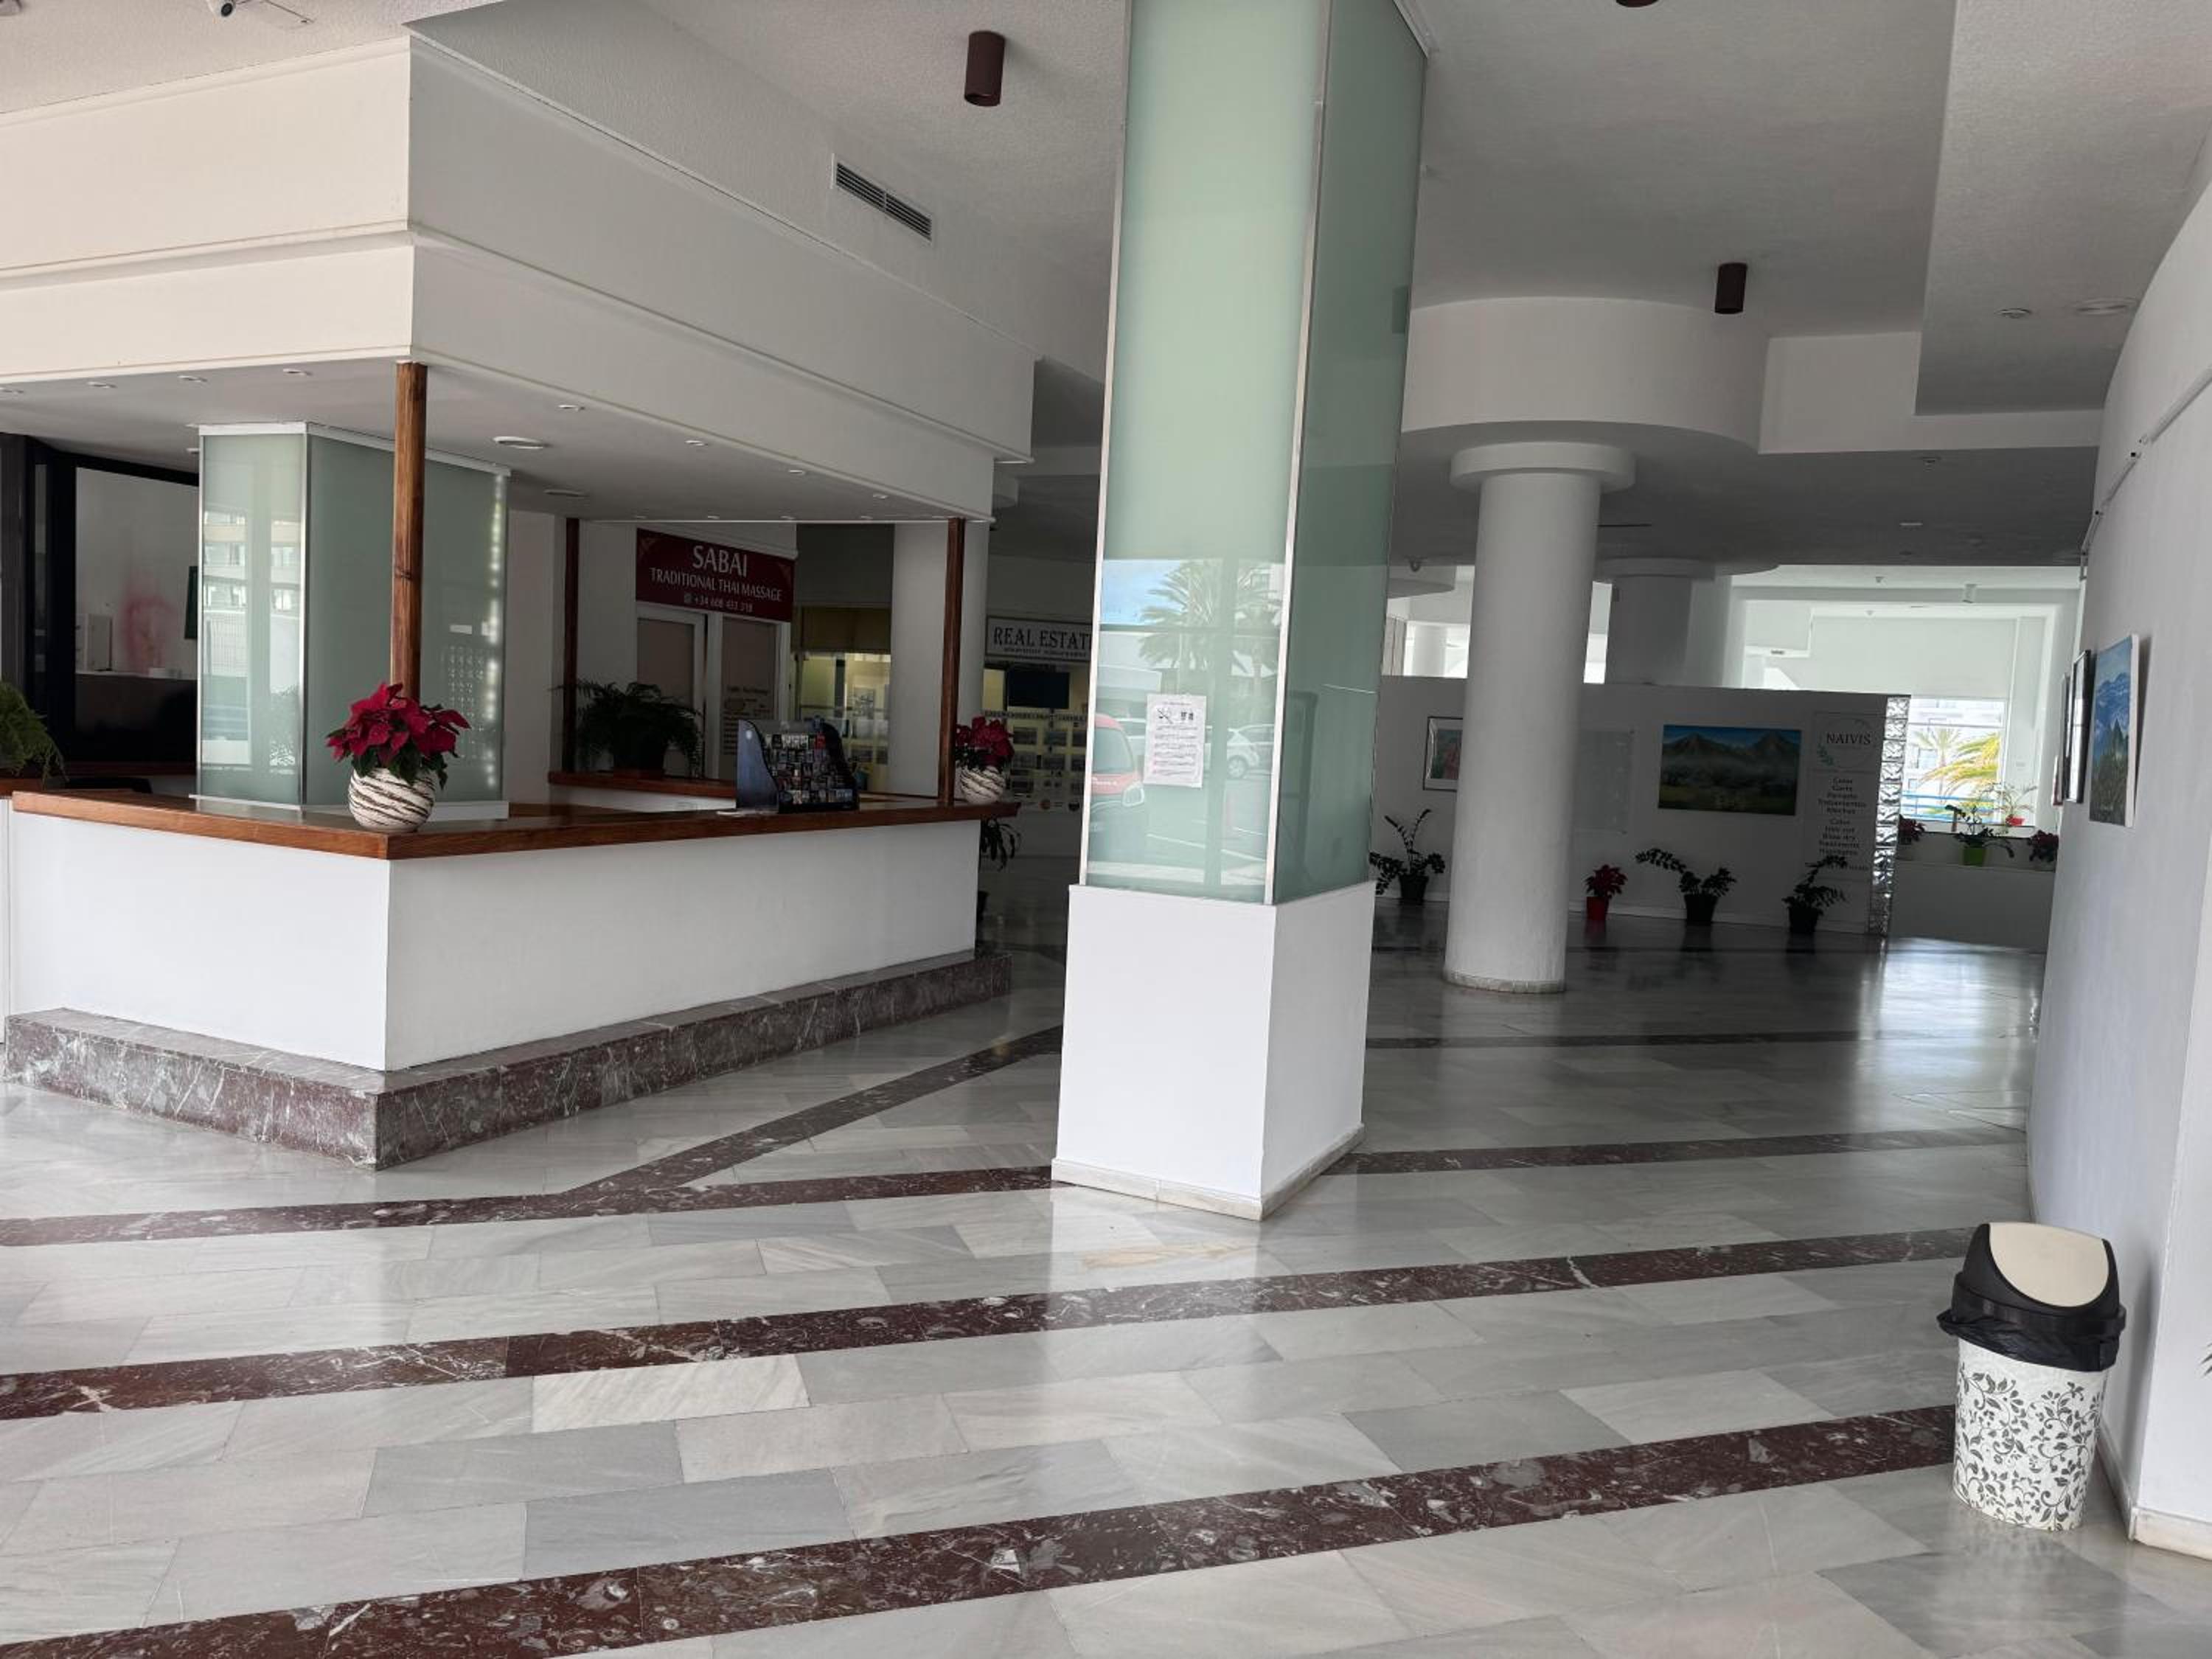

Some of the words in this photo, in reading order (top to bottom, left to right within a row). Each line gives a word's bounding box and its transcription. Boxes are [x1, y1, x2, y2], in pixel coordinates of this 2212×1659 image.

[693, 545, 747, 577] SABAI
[650, 568, 715, 590] TRADITIONAL
[719, 580, 740, 594] THAI
[742, 584, 782, 601] MASSAGE
[994, 627, 1035, 646] REAL
[1826, 733, 1871, 745] NAIVIS
